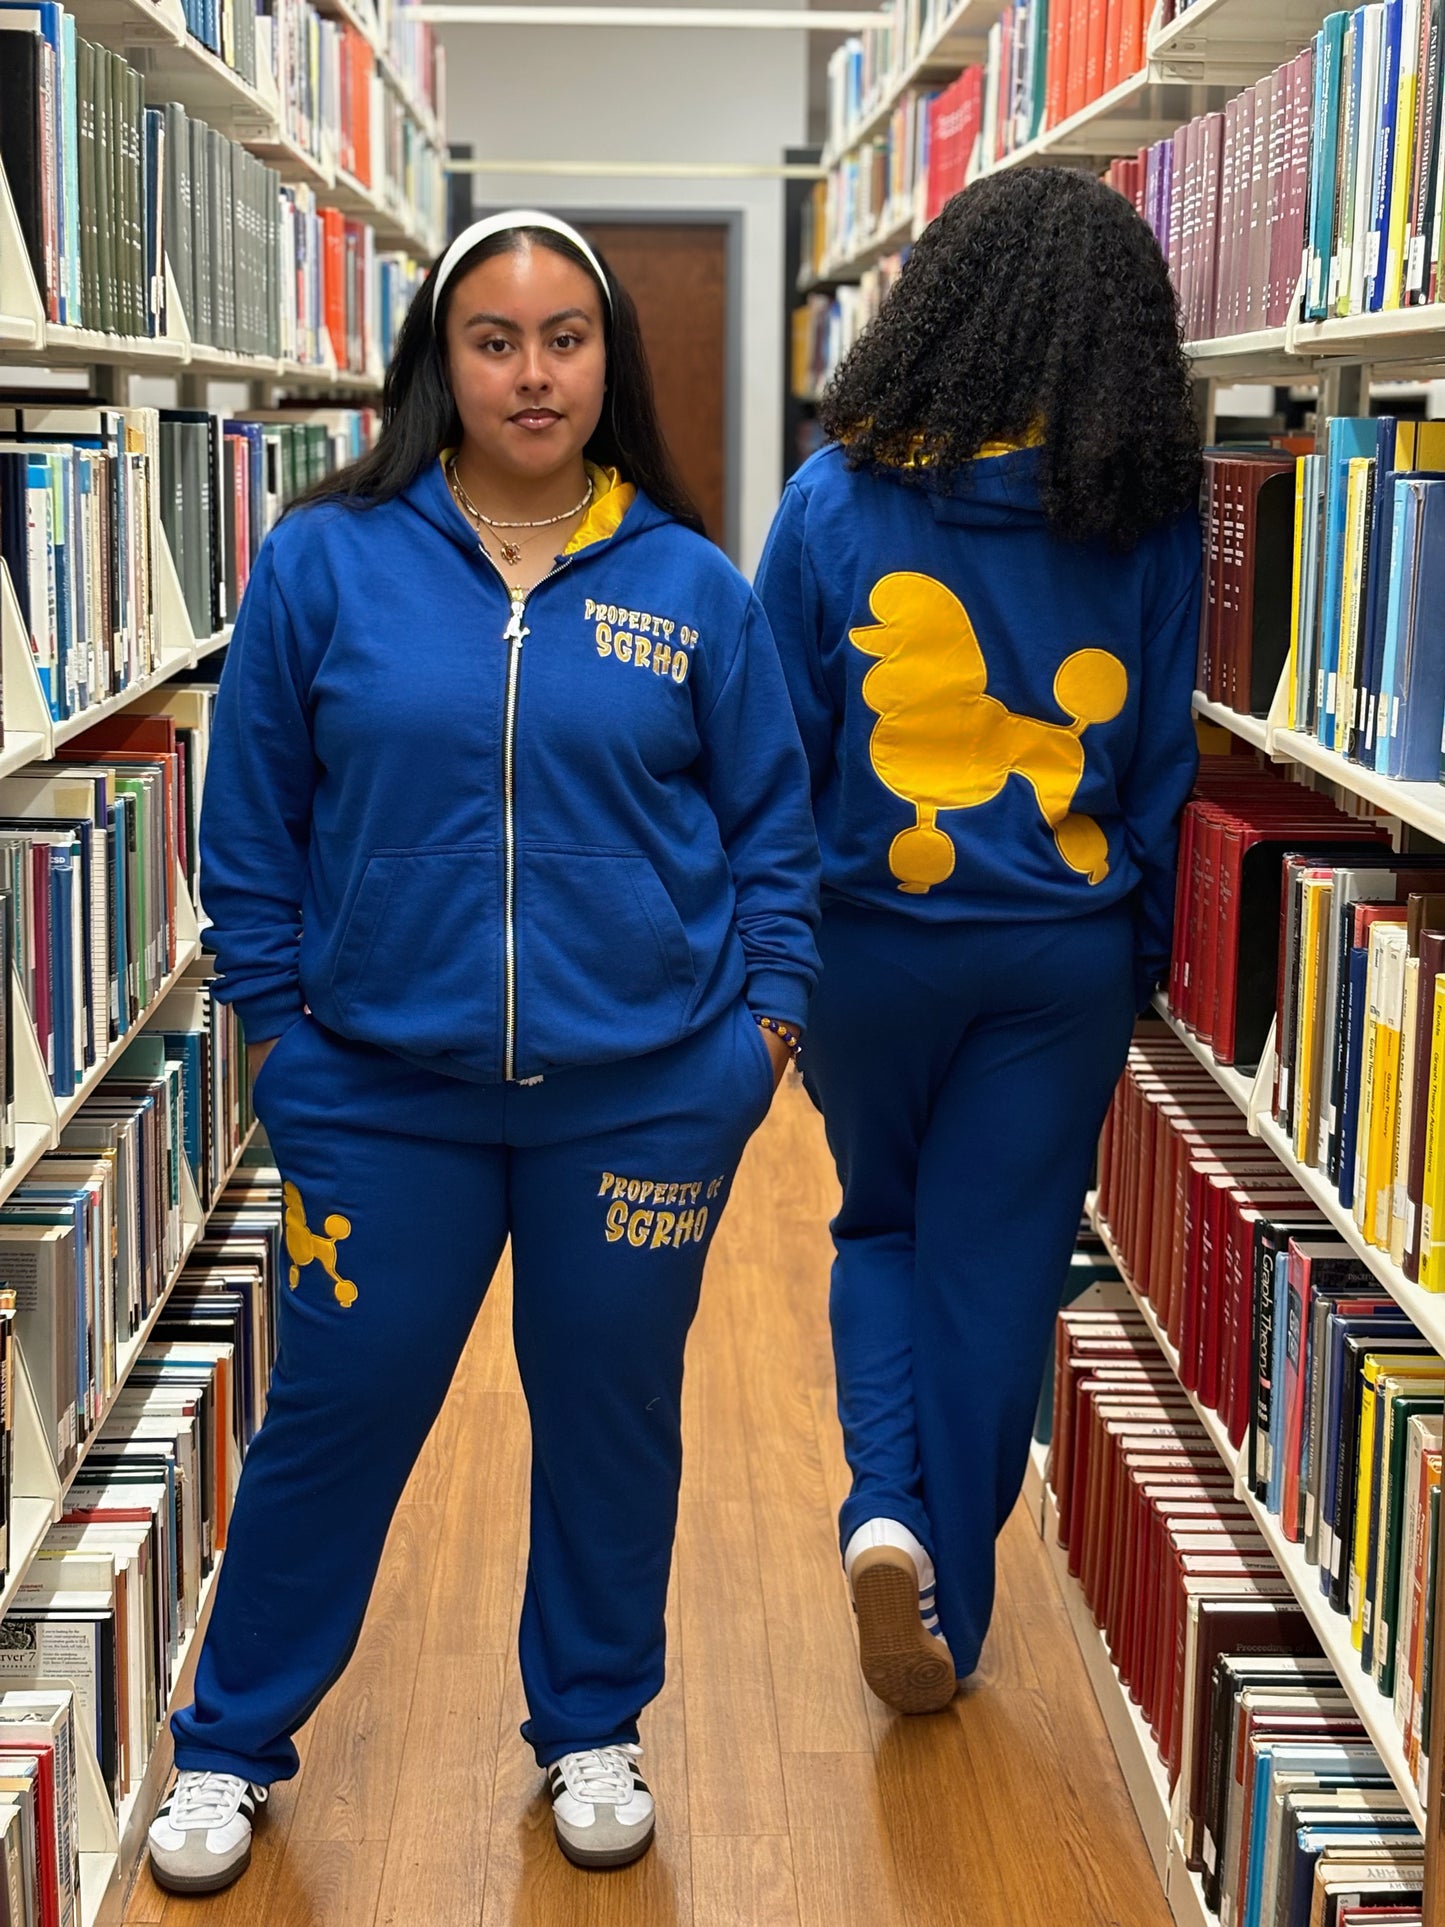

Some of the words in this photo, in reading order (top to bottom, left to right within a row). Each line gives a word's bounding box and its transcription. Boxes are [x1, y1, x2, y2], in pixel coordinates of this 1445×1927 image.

[1425, 25, 1438, 125] ENUMERATIVE
[1380, 127, 1390, 202] Combinatorics
[1361, 515, 1371, 588] TECHNIQUES
[584, 598, 674, 641] PROPERTY
[680, 625, 699, 649] OF
[595, 621, 688, 683] SGRHO
[1366, 1060, 1374, 1086] Theory
[1430, 1084, 1438, 1115] Theory
[1383, 1106, 1391, 1139] Theory
[1394, 1089, 1402, 1177] ALGORITHMS
[1427, 1116, 1436, 1173] Applications
[597, 1171, 702, 1206] PROPERTY
[604, 1200, 709, 1250] SGRHO
[1260, 1253, 1274, 1308] Graph
[1259, 1314, 1273, 1377] Theory
[1311, 1356, 1319, 1392] PEARLS
[1307, 1443, 1315, 1481] THEORY
[29, 1651, 36, 1662] 7
[1236, 1643, 1292, 1655] Proceedings
[60, 1722, 70, 1824] INFORMATION
[57, 1806, 65, 1885] PROCEDURES
[62, 1825, 71, 1897] SECURITY
